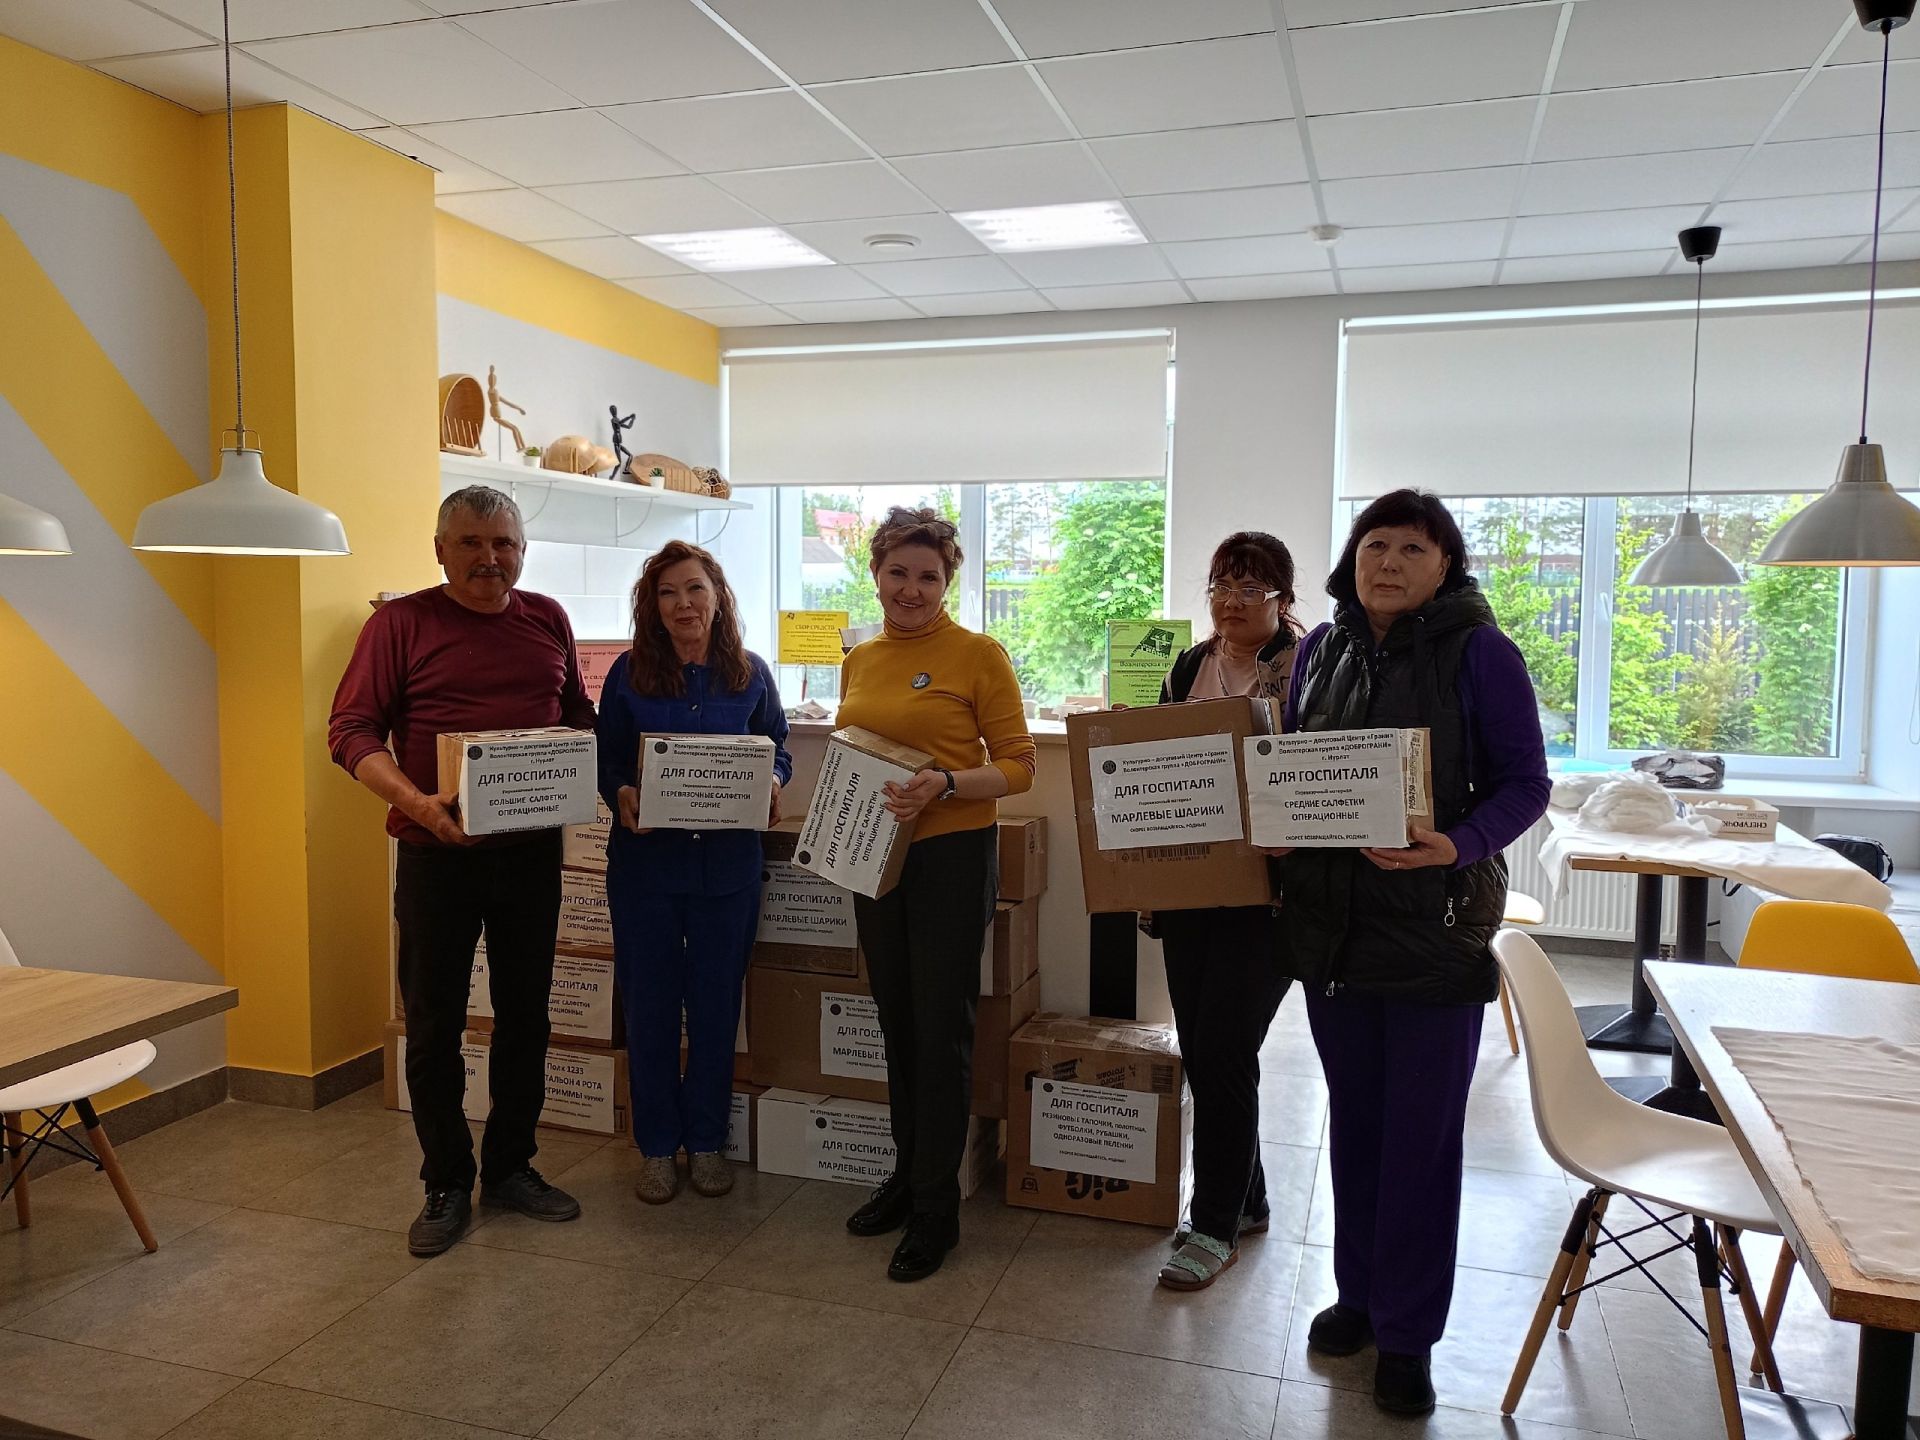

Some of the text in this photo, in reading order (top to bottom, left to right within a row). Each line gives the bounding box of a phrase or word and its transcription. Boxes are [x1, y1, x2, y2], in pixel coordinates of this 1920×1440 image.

[1313, 737, 1346, 745] досуговый
[1347, 734, 1366, 742] Центр
[478, 768, 577, 787] ДЛЯ ГОСПИТАЛЯ
[661, 768, 754, 780] ДЛЯ ГОСПИТАЛЯ
[1268, 767, 1379, 786] ДЛЯ ГОСПИТАЛЯ
[1115, 778, 1215, 799] ДЛЯ ГОСПИТАЛЯ
[490, 794, 567, 806] БОЛЬШИЕ САЛФЕТКИ
[661, 791, 751, 800] ПЕРЕВЯЗОЧНЫЕ САЛФЕТКИ
[1284, 798, 1365, 809] СРЕДНИЕ САЛФЕТКИ
[498, 805, 559, 816] ОПЕРАЦИОННЫЕ
[1111, 805, 1224, 823] МАРЛЕВЫЕ ШАРИКИ
[825, 842, 839, 868] ДЛЯ
[834, 772, 861, 840] ГОСПИТАЛЯ
[1292, 812, 1359, 822] ОПЕРАЦИОННЫЕ
[849, 791, 879, 866] БОЛЬШИЕ САЛФЕТКИ
[1723, 820, 1767, 828] СНЕГУРОЧК
[574, 896, 609, 907] ГОСПИТ
[767, 892, 842, 904] ДЛЯ ГОСПИТАЛЯ
[764, 913, 847, 926] МАРЛЕВЫЕ ШАРИКИ
[552, 980, 598, 992] ОСПИТАЛЯ
[837, 1026, 856, 1036] ДЛЯ
[833, 1047, 879, 1059] МАРЛЕВЫЕ
[547, 1062, 566, 1072] Полк
[545, 1074, 573, 1086] ТАЛЬОН
[582, 1080, 602, 1090] РОТА
[1050, 1097, 1139, 1118] ДЛЯ ГОСПИТАЛЯ
[1042, 1111, 1081, 1123] РЕЗИНОВЫЕ
[1081, 1118, 1113, 1128] ТАПОЧКИ,
[1058, 1124, 1130, 1140] ФУТБОЛКИ, РУБАШКИ,
[1053, 1133, 1134, 1149] ОДНОРАЗОВЫЕ ПЕЛЕНКИ
[822, 1140, 896, 1156] ДЛЯ ГОСПИТАЛ
[818, 1161, 895, 1177] МАРЛЕВЫЕ ШАРИ
